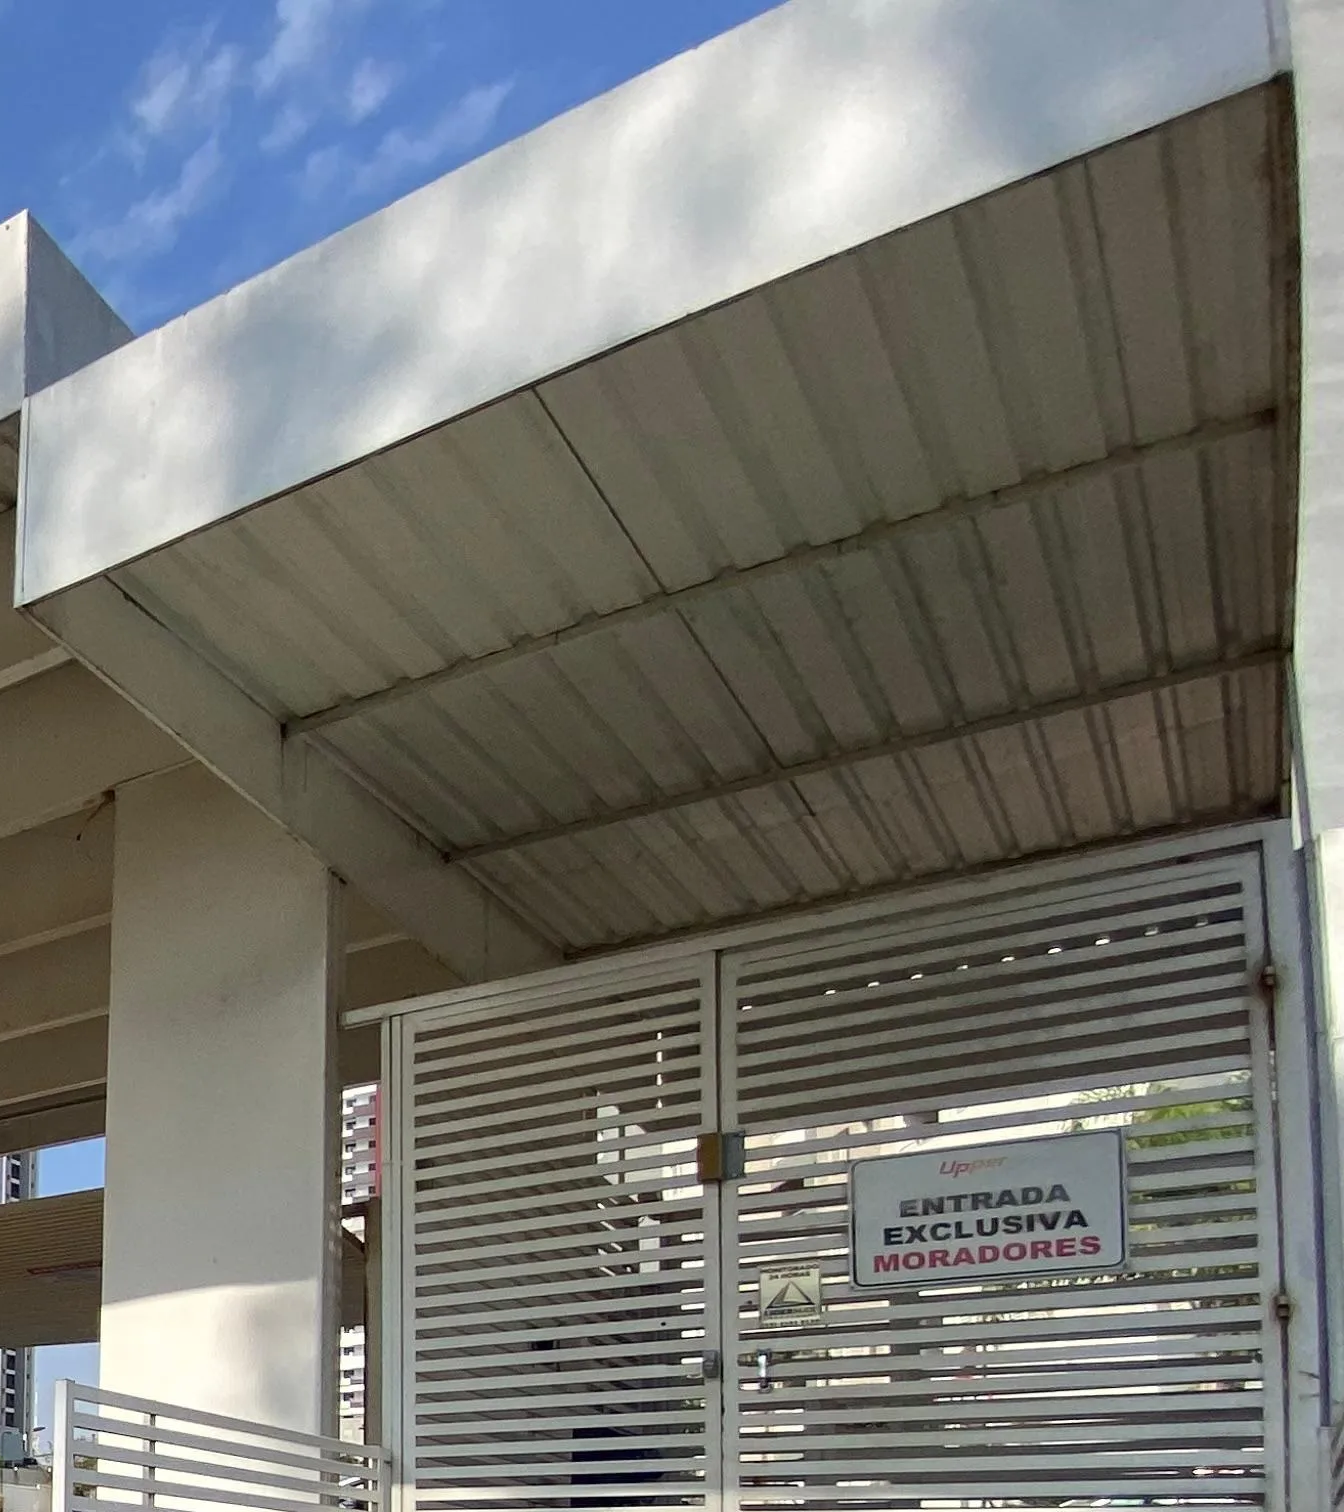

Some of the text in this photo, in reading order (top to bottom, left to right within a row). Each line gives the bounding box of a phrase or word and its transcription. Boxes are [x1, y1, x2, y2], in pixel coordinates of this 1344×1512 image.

[898, 1183, 1072, 1218] ENTRADA
[883, 1209, 1089, 1246] EXCLUSIVA
[873, 1235, 1102, 1274] MORADORES
